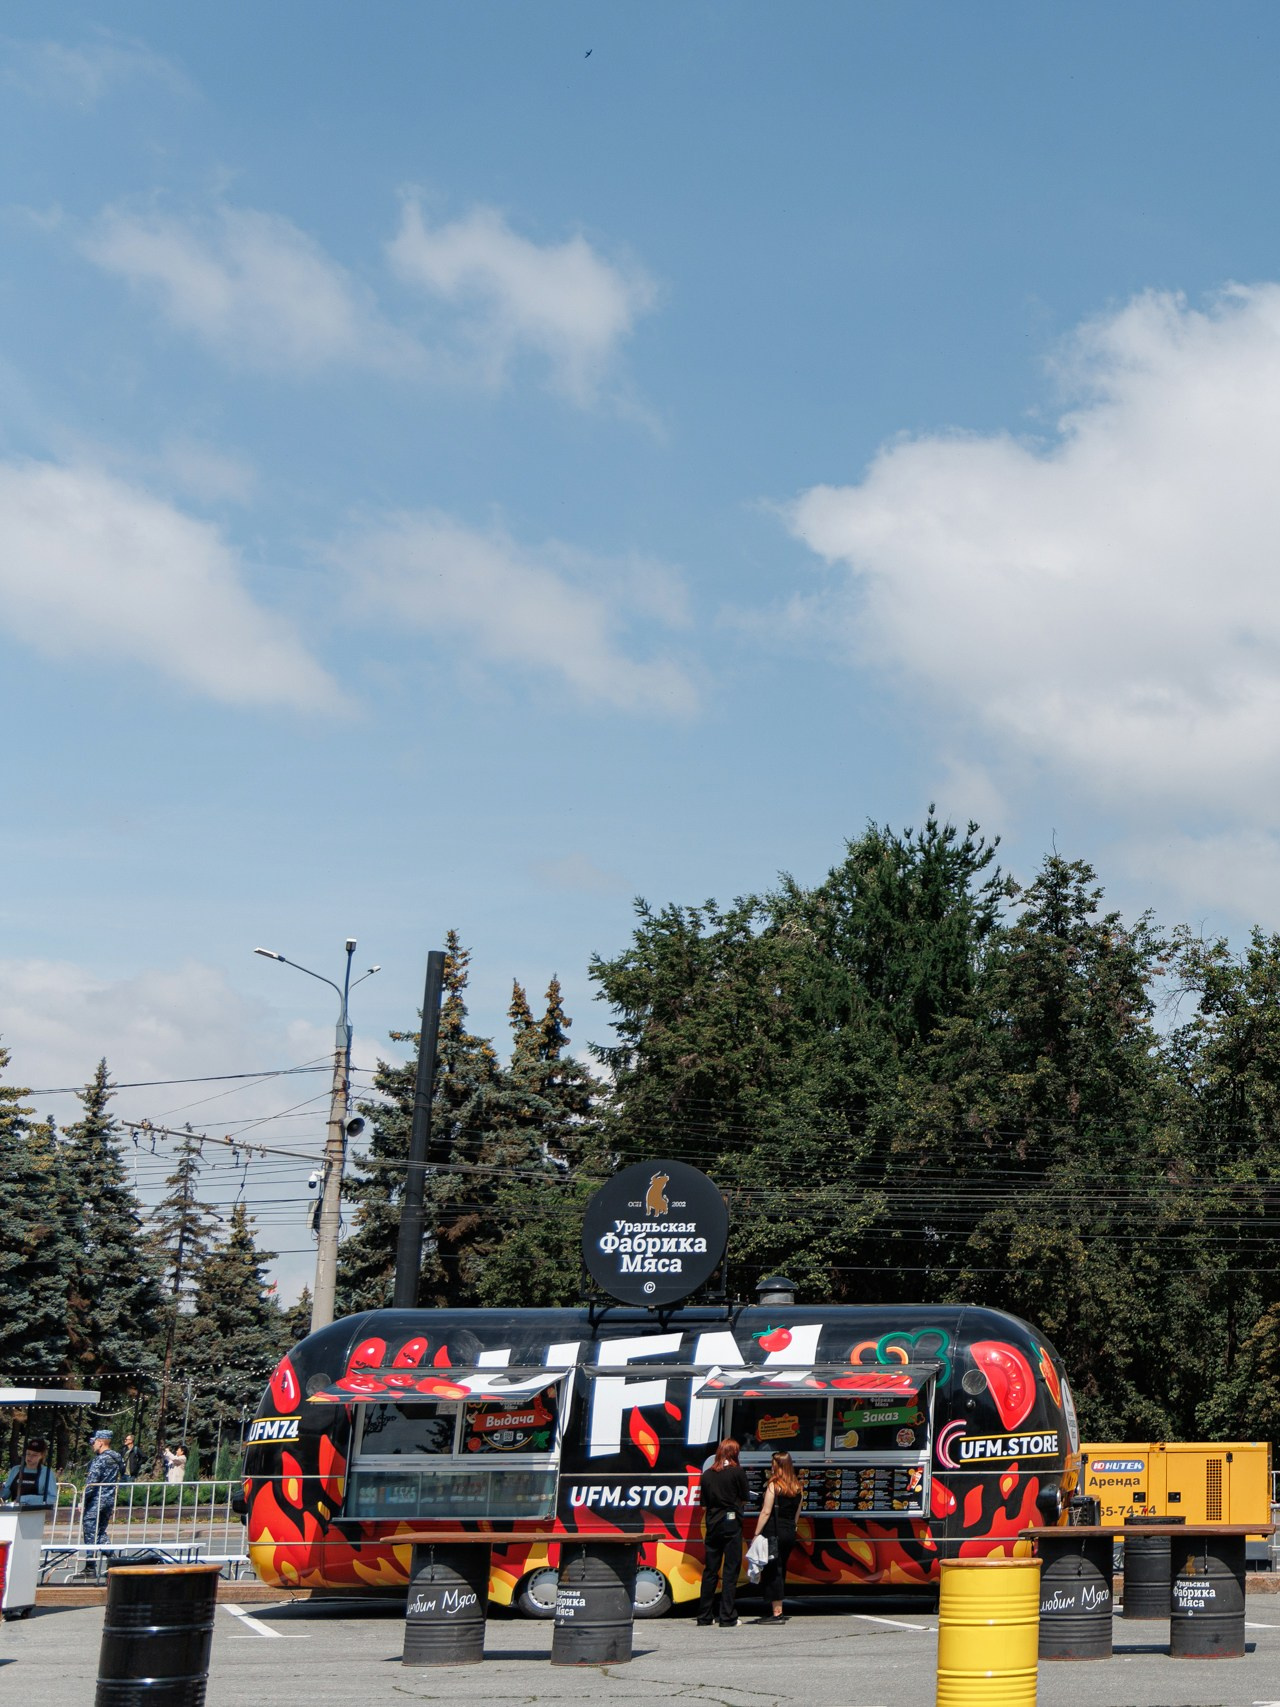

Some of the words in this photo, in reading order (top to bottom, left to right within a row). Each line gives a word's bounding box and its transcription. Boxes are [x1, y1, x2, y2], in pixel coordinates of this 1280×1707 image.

[614, 1220, 697, 1235] Уральская
[599, 1232, 708, 1257] Фабрика
[620, 1254, 683, 1273] Мяса
[485, 1413, 535, 1428] Выдача
[862, 1411, 899, 1423] Заказ
[248, 1420, 299, 1441] UFM74
[960, 1435, 1059, 1458] UFM.STORE
[1089, 1476, 1141, 1488] Аренда
[570, 1485, 701, 1506] UFM.STORE
[1176, 1580, 1210, 1588] Уральская
[442, 1588, 477, 1614] Мясо
[1081, 1584, 1110, 1610] Мясо
[1173, 1586, 1216, 1600] Фабрика
[1179, 1597, 1205, 1608] Мяса
